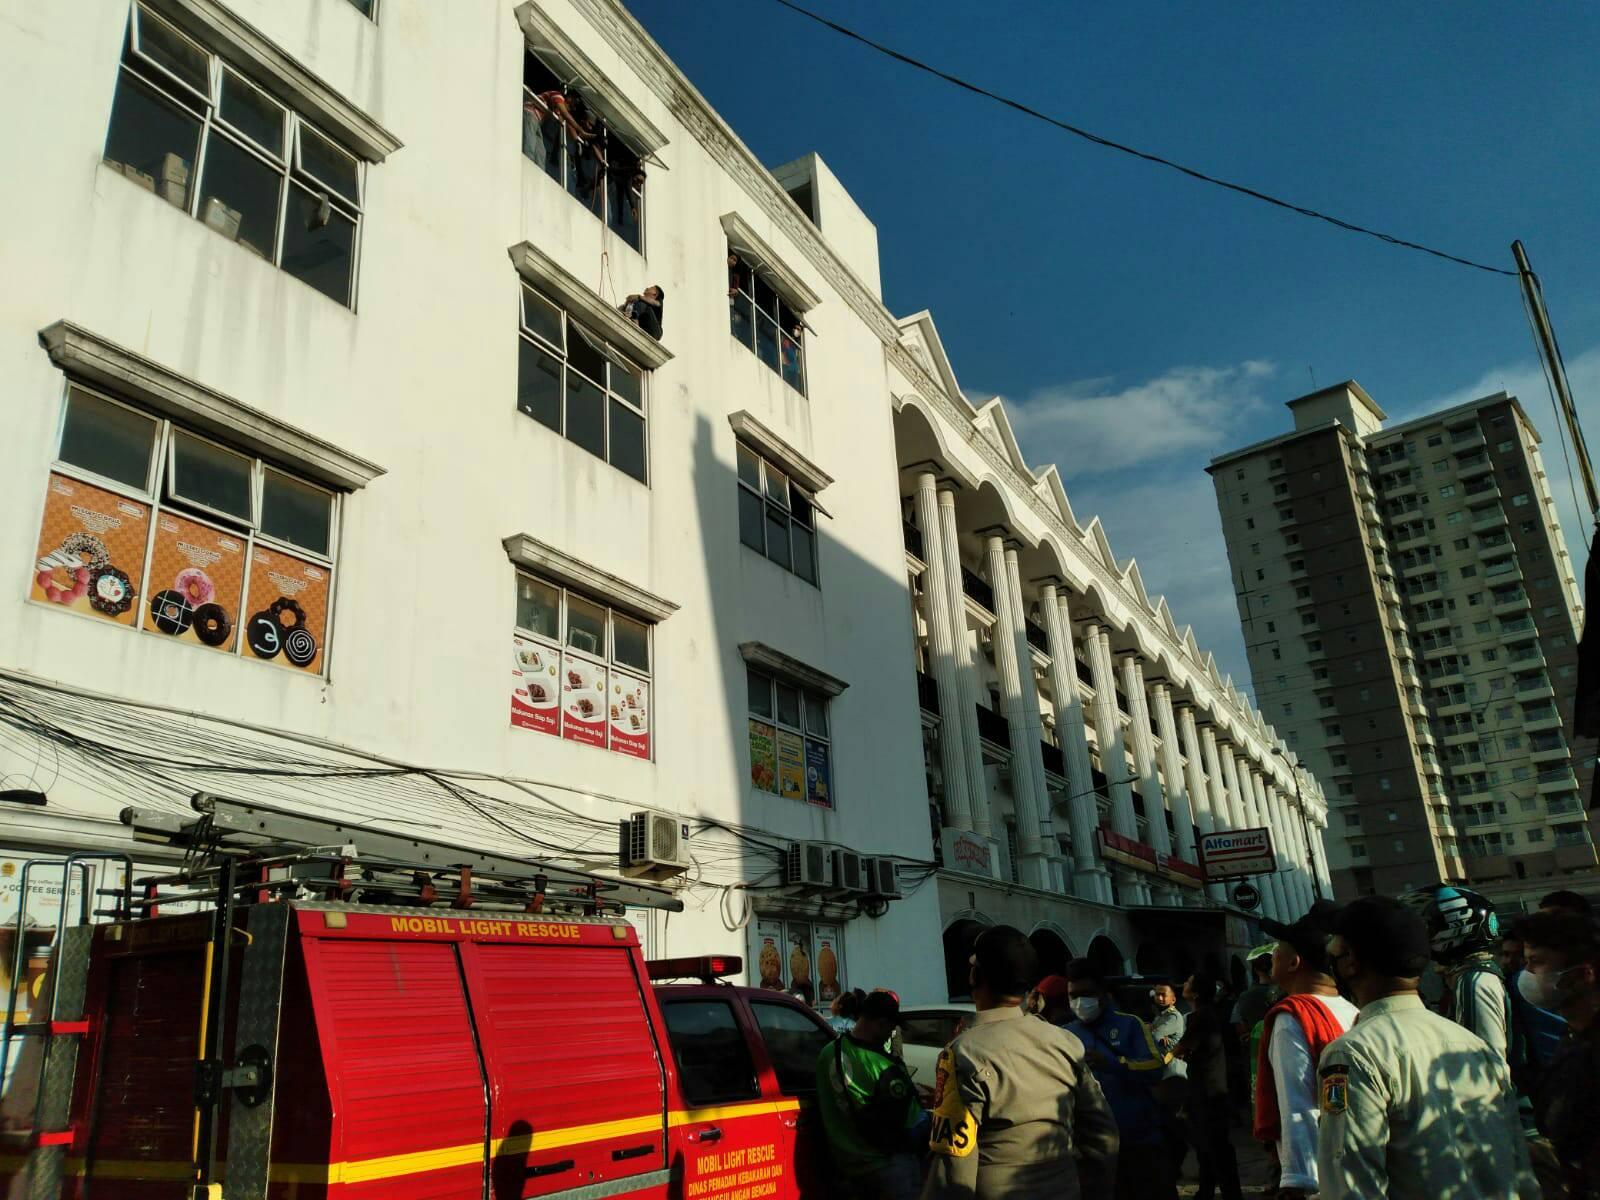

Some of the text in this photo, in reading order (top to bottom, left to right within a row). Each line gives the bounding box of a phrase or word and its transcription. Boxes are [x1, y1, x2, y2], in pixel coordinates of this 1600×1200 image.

[1205, 833, 1264, 849] Alfamart
[9, 884, 76, 896] COFEE SERS
[391, 917, 581, 938] MOBIL LIGHT RESCUE
[697, 1144, 775, 1175] MOBIL LIGHT RESCUE
[688, 1180, 707, 1197] DINAS
[771, 1164, 783, 1178] DAN
[751, 1182, 776, 1198] BENCANA
